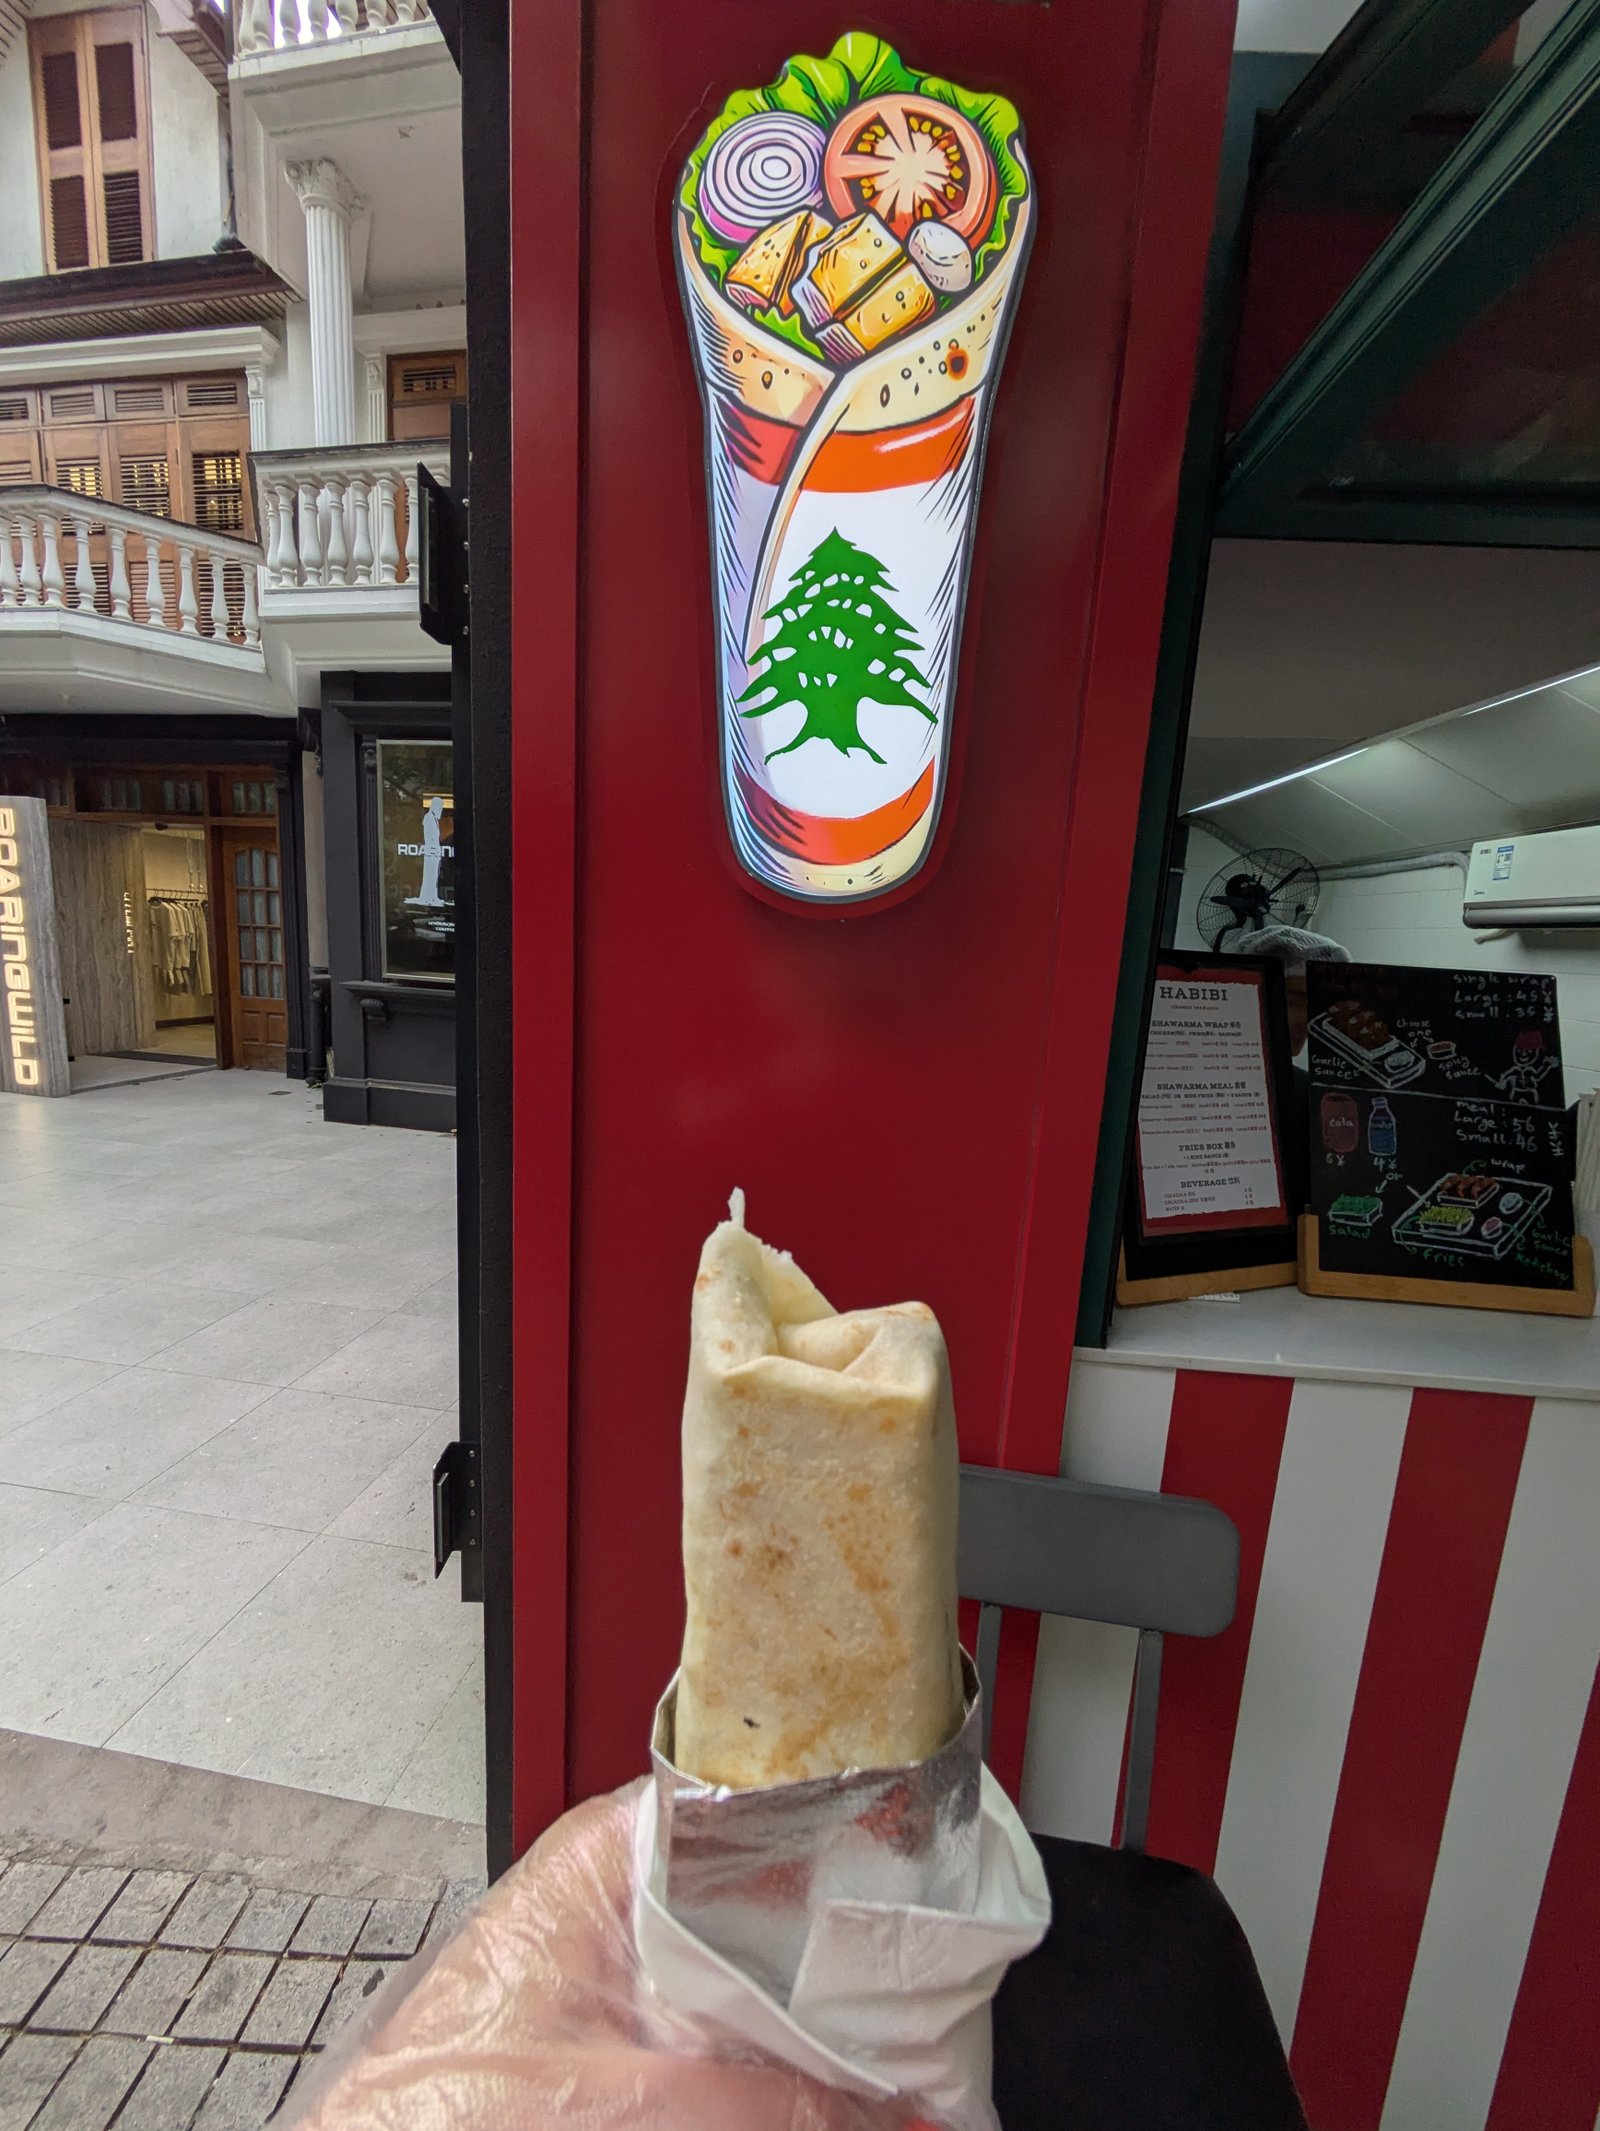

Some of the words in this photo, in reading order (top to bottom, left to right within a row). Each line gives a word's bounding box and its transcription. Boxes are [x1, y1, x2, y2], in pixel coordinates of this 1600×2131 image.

[1159, 986, 1229, 1001] HABIBI
[1151, 1019, 1203, 1028] SHAWARMA
[1203, 1020, 1229, 1029] WRAP
[1156, 1083, 1209, 1091] SHAWARMA
[1210, 1082, 1234, 1090] MEAL
[1454, 1111, 1497, 1132] Large
[1512, 1116, 1535, 1132] 56
[1178, 1144, 1205, 1152] FRIES
[1206, 1143, 1224, 1151] BOX
[1491, 1158, 1526, 1174] wrap
[1180, 1179, 1227, 1188] BEVERAGE
